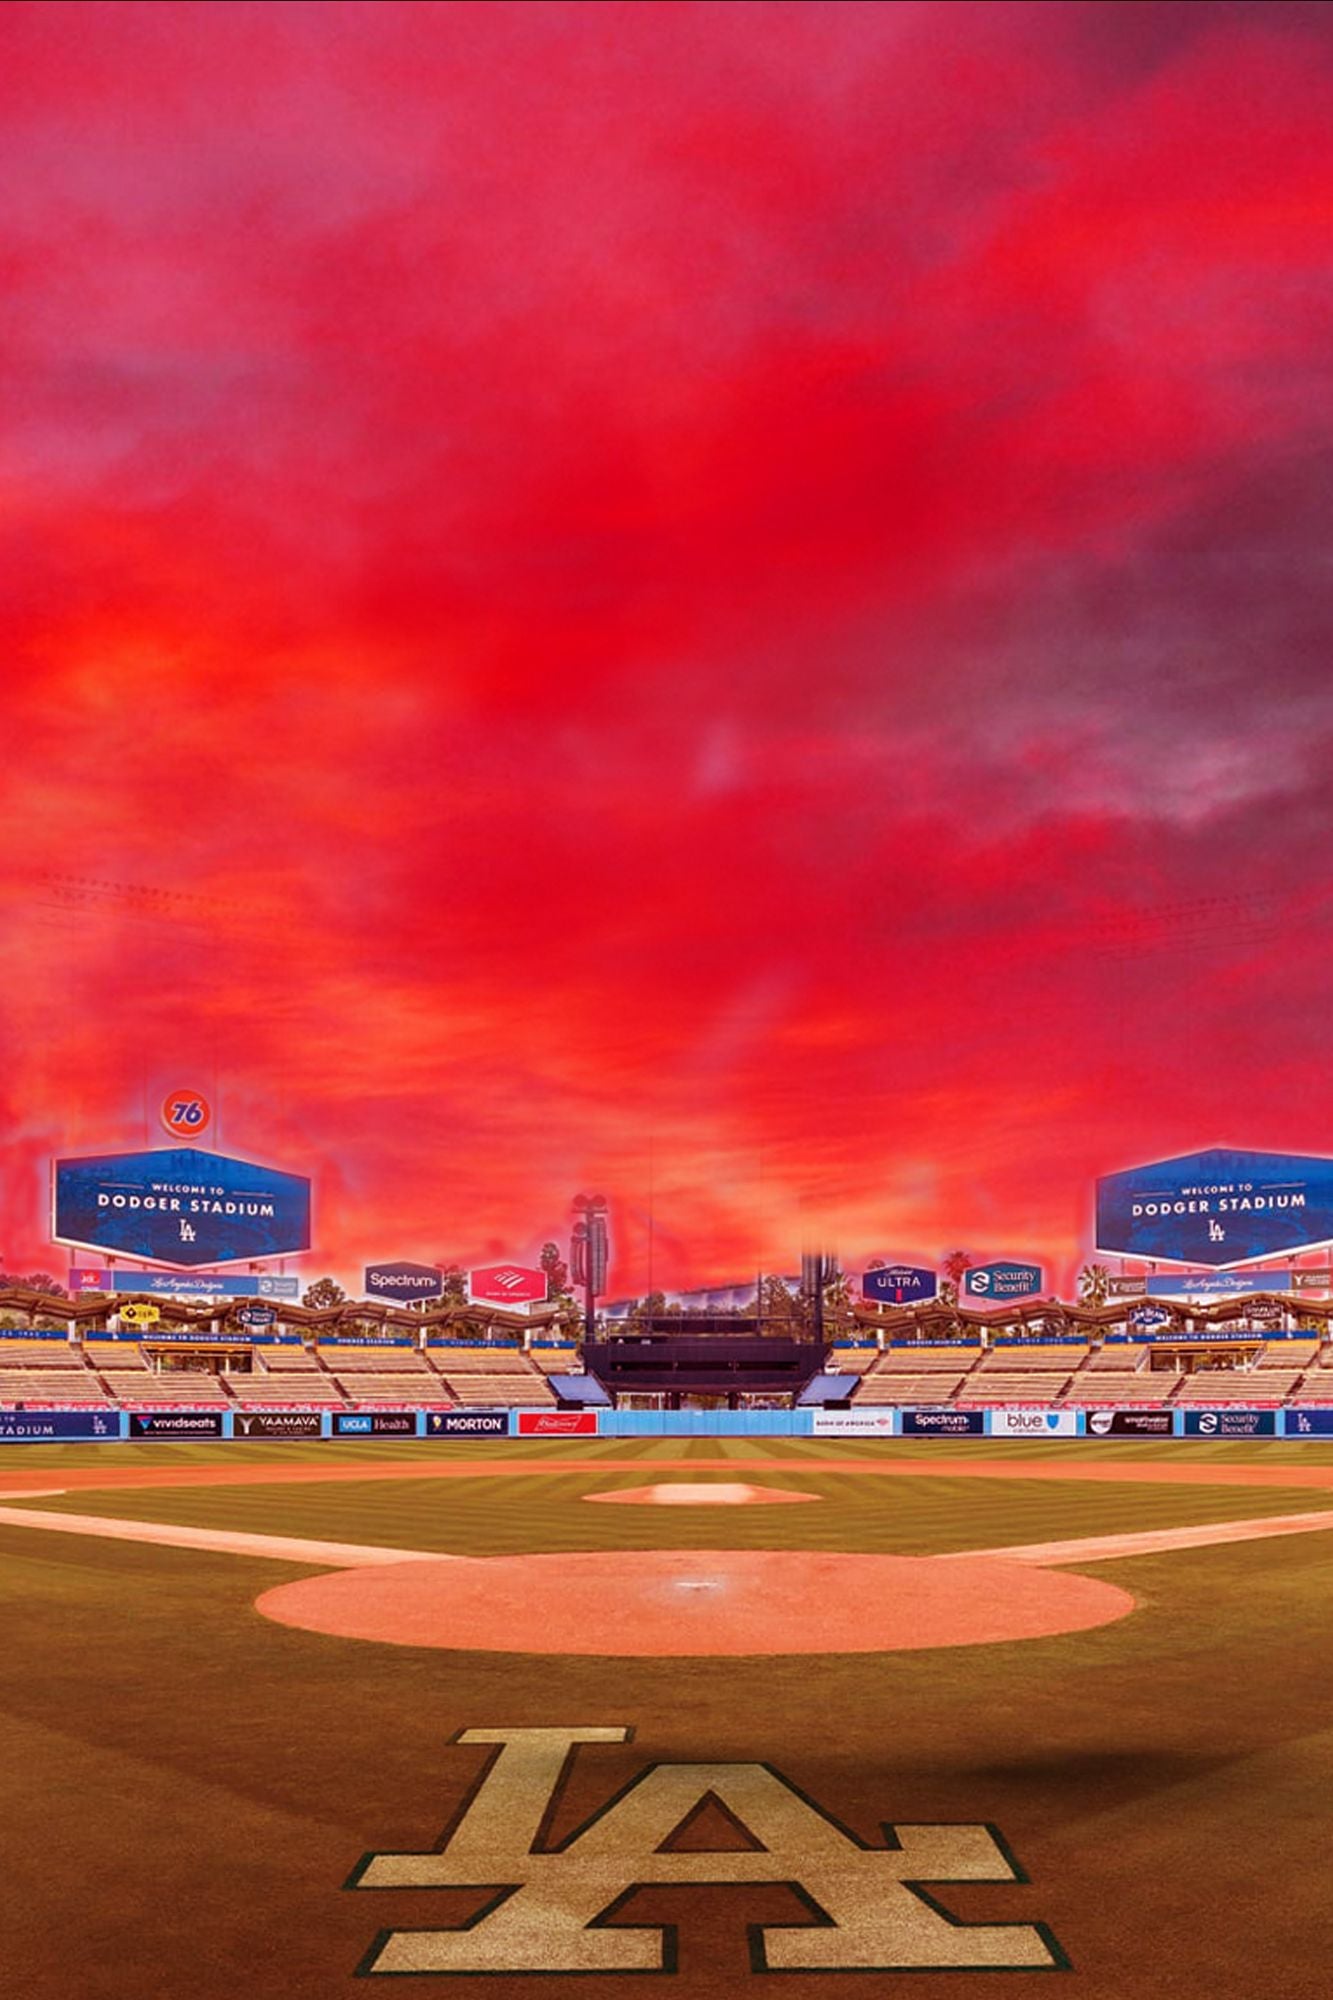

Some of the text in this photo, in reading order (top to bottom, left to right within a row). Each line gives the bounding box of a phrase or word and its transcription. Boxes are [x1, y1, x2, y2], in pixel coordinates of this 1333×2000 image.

[172, 1102, 202, 1124] 76
[152, 1183, 224, 1196] WELCOME TO
[1181, 1183, 1253, 1196] WELCOME TO
[98, 1193, 275, 1217] DODGER STADIUM
[1132, 1194, 1306, 1217] DODGER STADIUM
[370, 1273, 434, 1289] Spectrum
[877, 1276, 921, 1288] ULTRA
[993, 1270, 1034, 1282] Security
[993, 1282, 1030, 1293] Benefit
[153, 1417, 216, 1428] vividseats
[342, 1418, 410, 1430] UCLA Health
[446, 1418, 502, 1430] MORTON
[915, 1414, 967, 1427] Spectrum
[1006, 1413, 1043, 1428] blue
[1221, 1413, 1260, 1425] Security
[1221, 1423, 1254, 1433] Benefit
[343, 1727, 1073, 1976] LA
